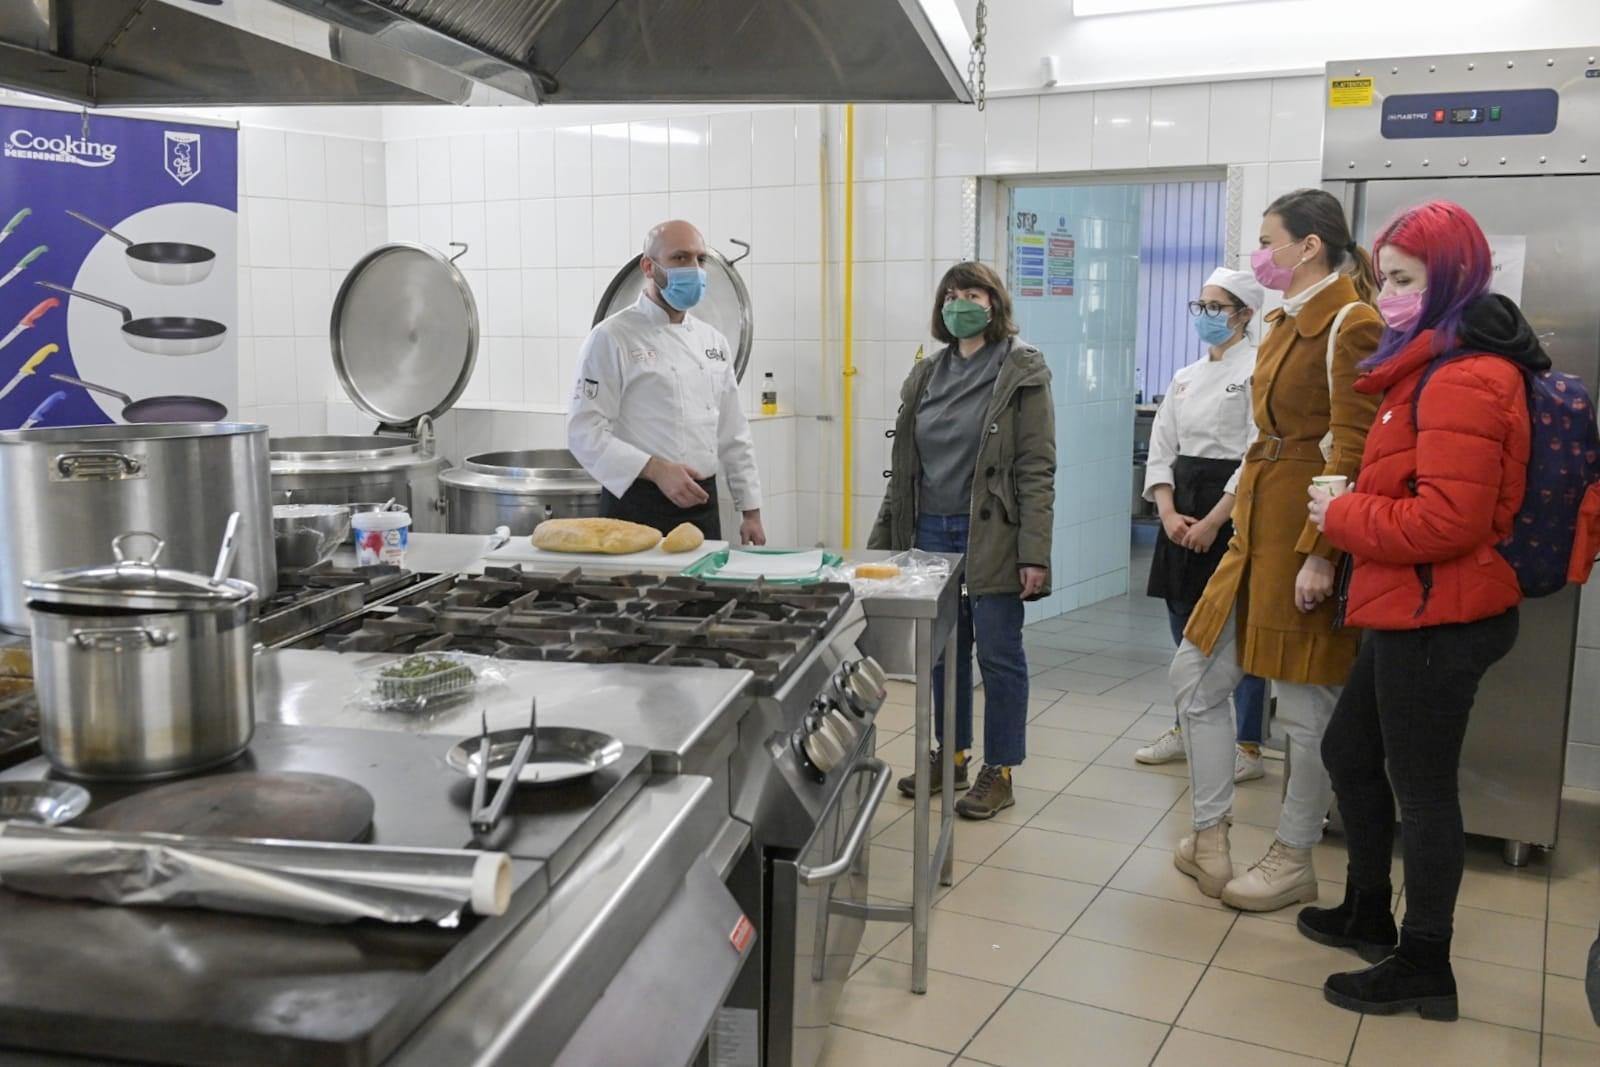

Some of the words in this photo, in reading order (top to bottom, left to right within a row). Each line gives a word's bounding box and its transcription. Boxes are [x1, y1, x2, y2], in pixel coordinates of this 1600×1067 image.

[10, 129, 117, 161] Cooking
[4, 148, 78, 163] HEINNER
[1016, 211, 1038, 231] STOP
